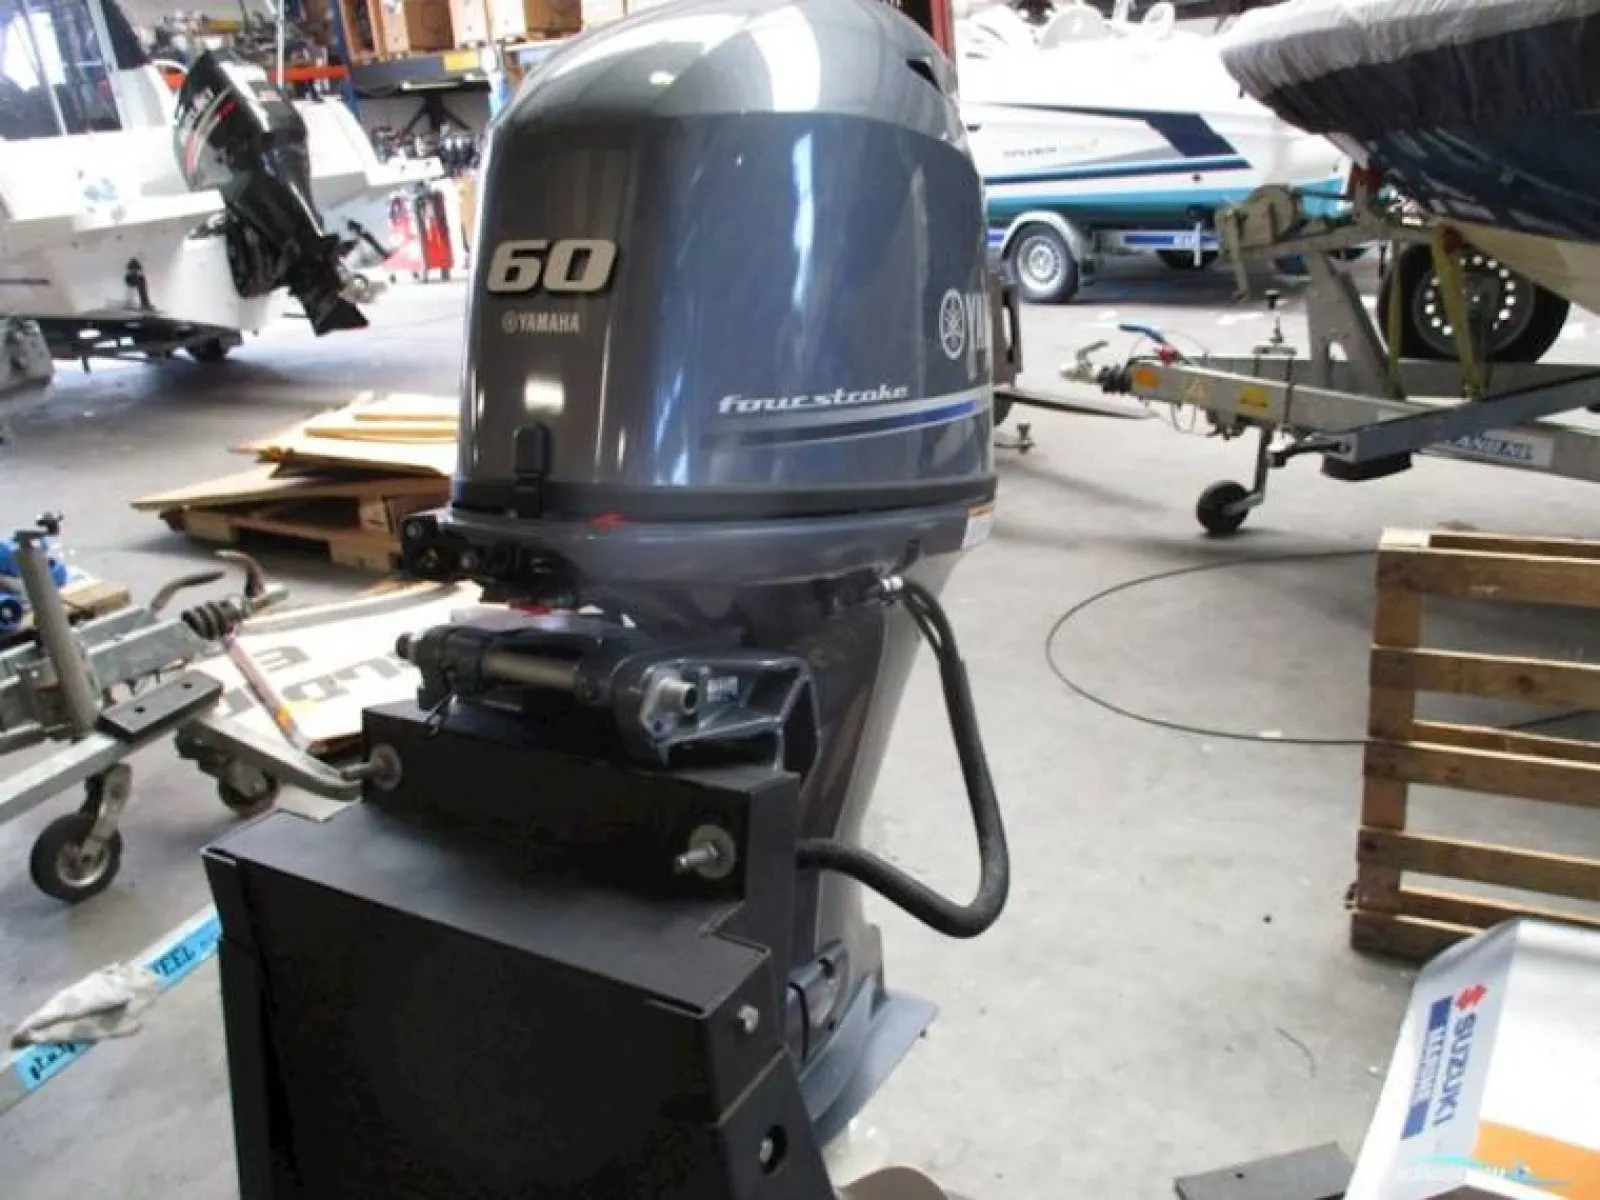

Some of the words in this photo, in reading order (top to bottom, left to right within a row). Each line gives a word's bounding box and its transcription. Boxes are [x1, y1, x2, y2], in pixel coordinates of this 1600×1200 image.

[487, 239, 617, 294] 60
[519, 311, 580, 333] YAMAHA
[1433, 1013, 1478, 1127] SUZUKI
